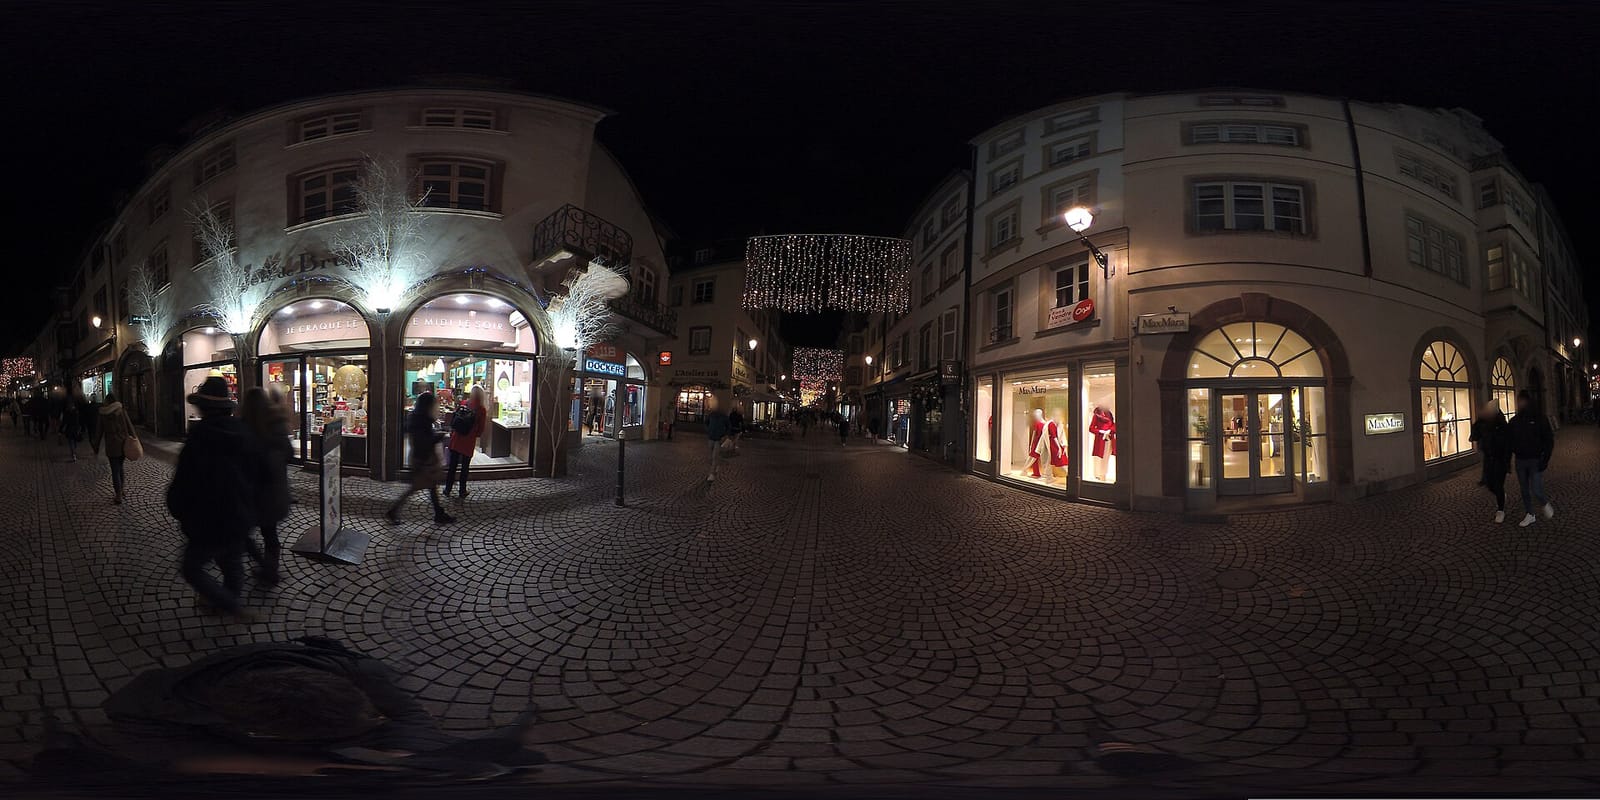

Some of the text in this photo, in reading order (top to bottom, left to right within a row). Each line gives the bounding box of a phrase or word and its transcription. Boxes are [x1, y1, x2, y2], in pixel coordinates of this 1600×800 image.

[286, 327, 295, 336] JE
[298, 321, 343, 334] CRAQUE
[424, 318, 453, 328] MIDI
[458, 319, 470, 329] LE
[475, 320, 504, 331] SOIR
[1142, 317, 1185, 329] MaxMara
[587, 361, 626, 374] DOCKERS
[1369, 418, 1403, 429] MaxMara
